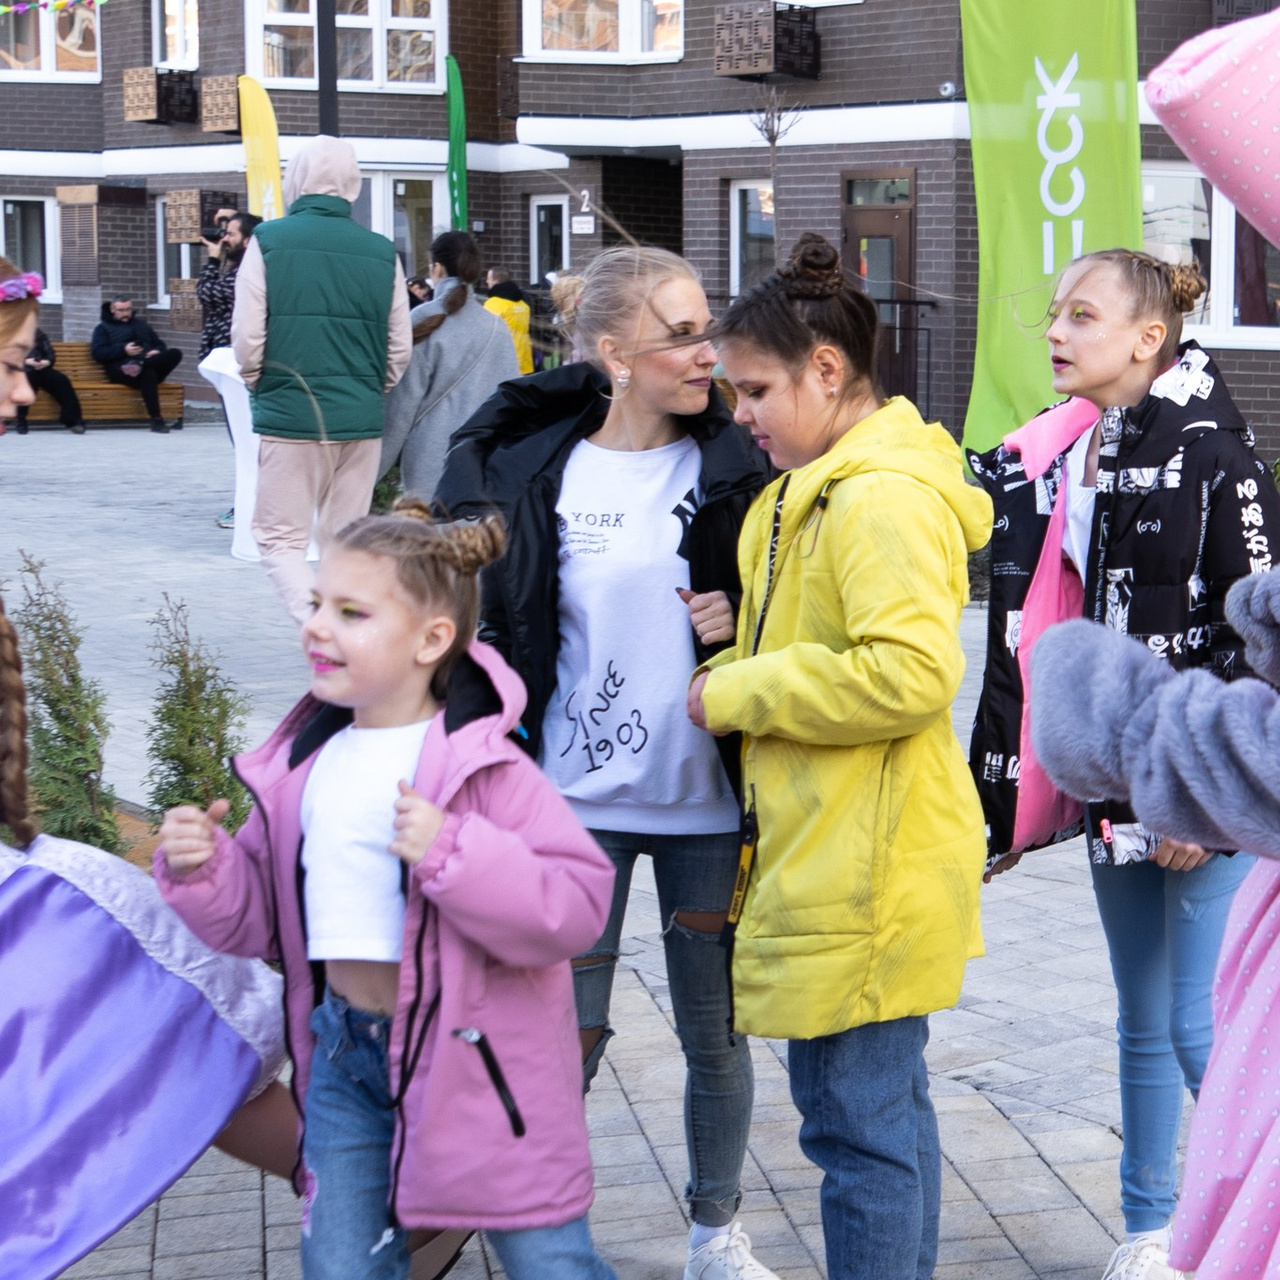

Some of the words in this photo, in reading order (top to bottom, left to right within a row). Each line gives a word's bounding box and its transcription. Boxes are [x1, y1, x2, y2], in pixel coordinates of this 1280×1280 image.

[580, 189, 591, 213] 2
[571, 511, 626, 528] YORK
[581, 708, 649, 774] 1903
